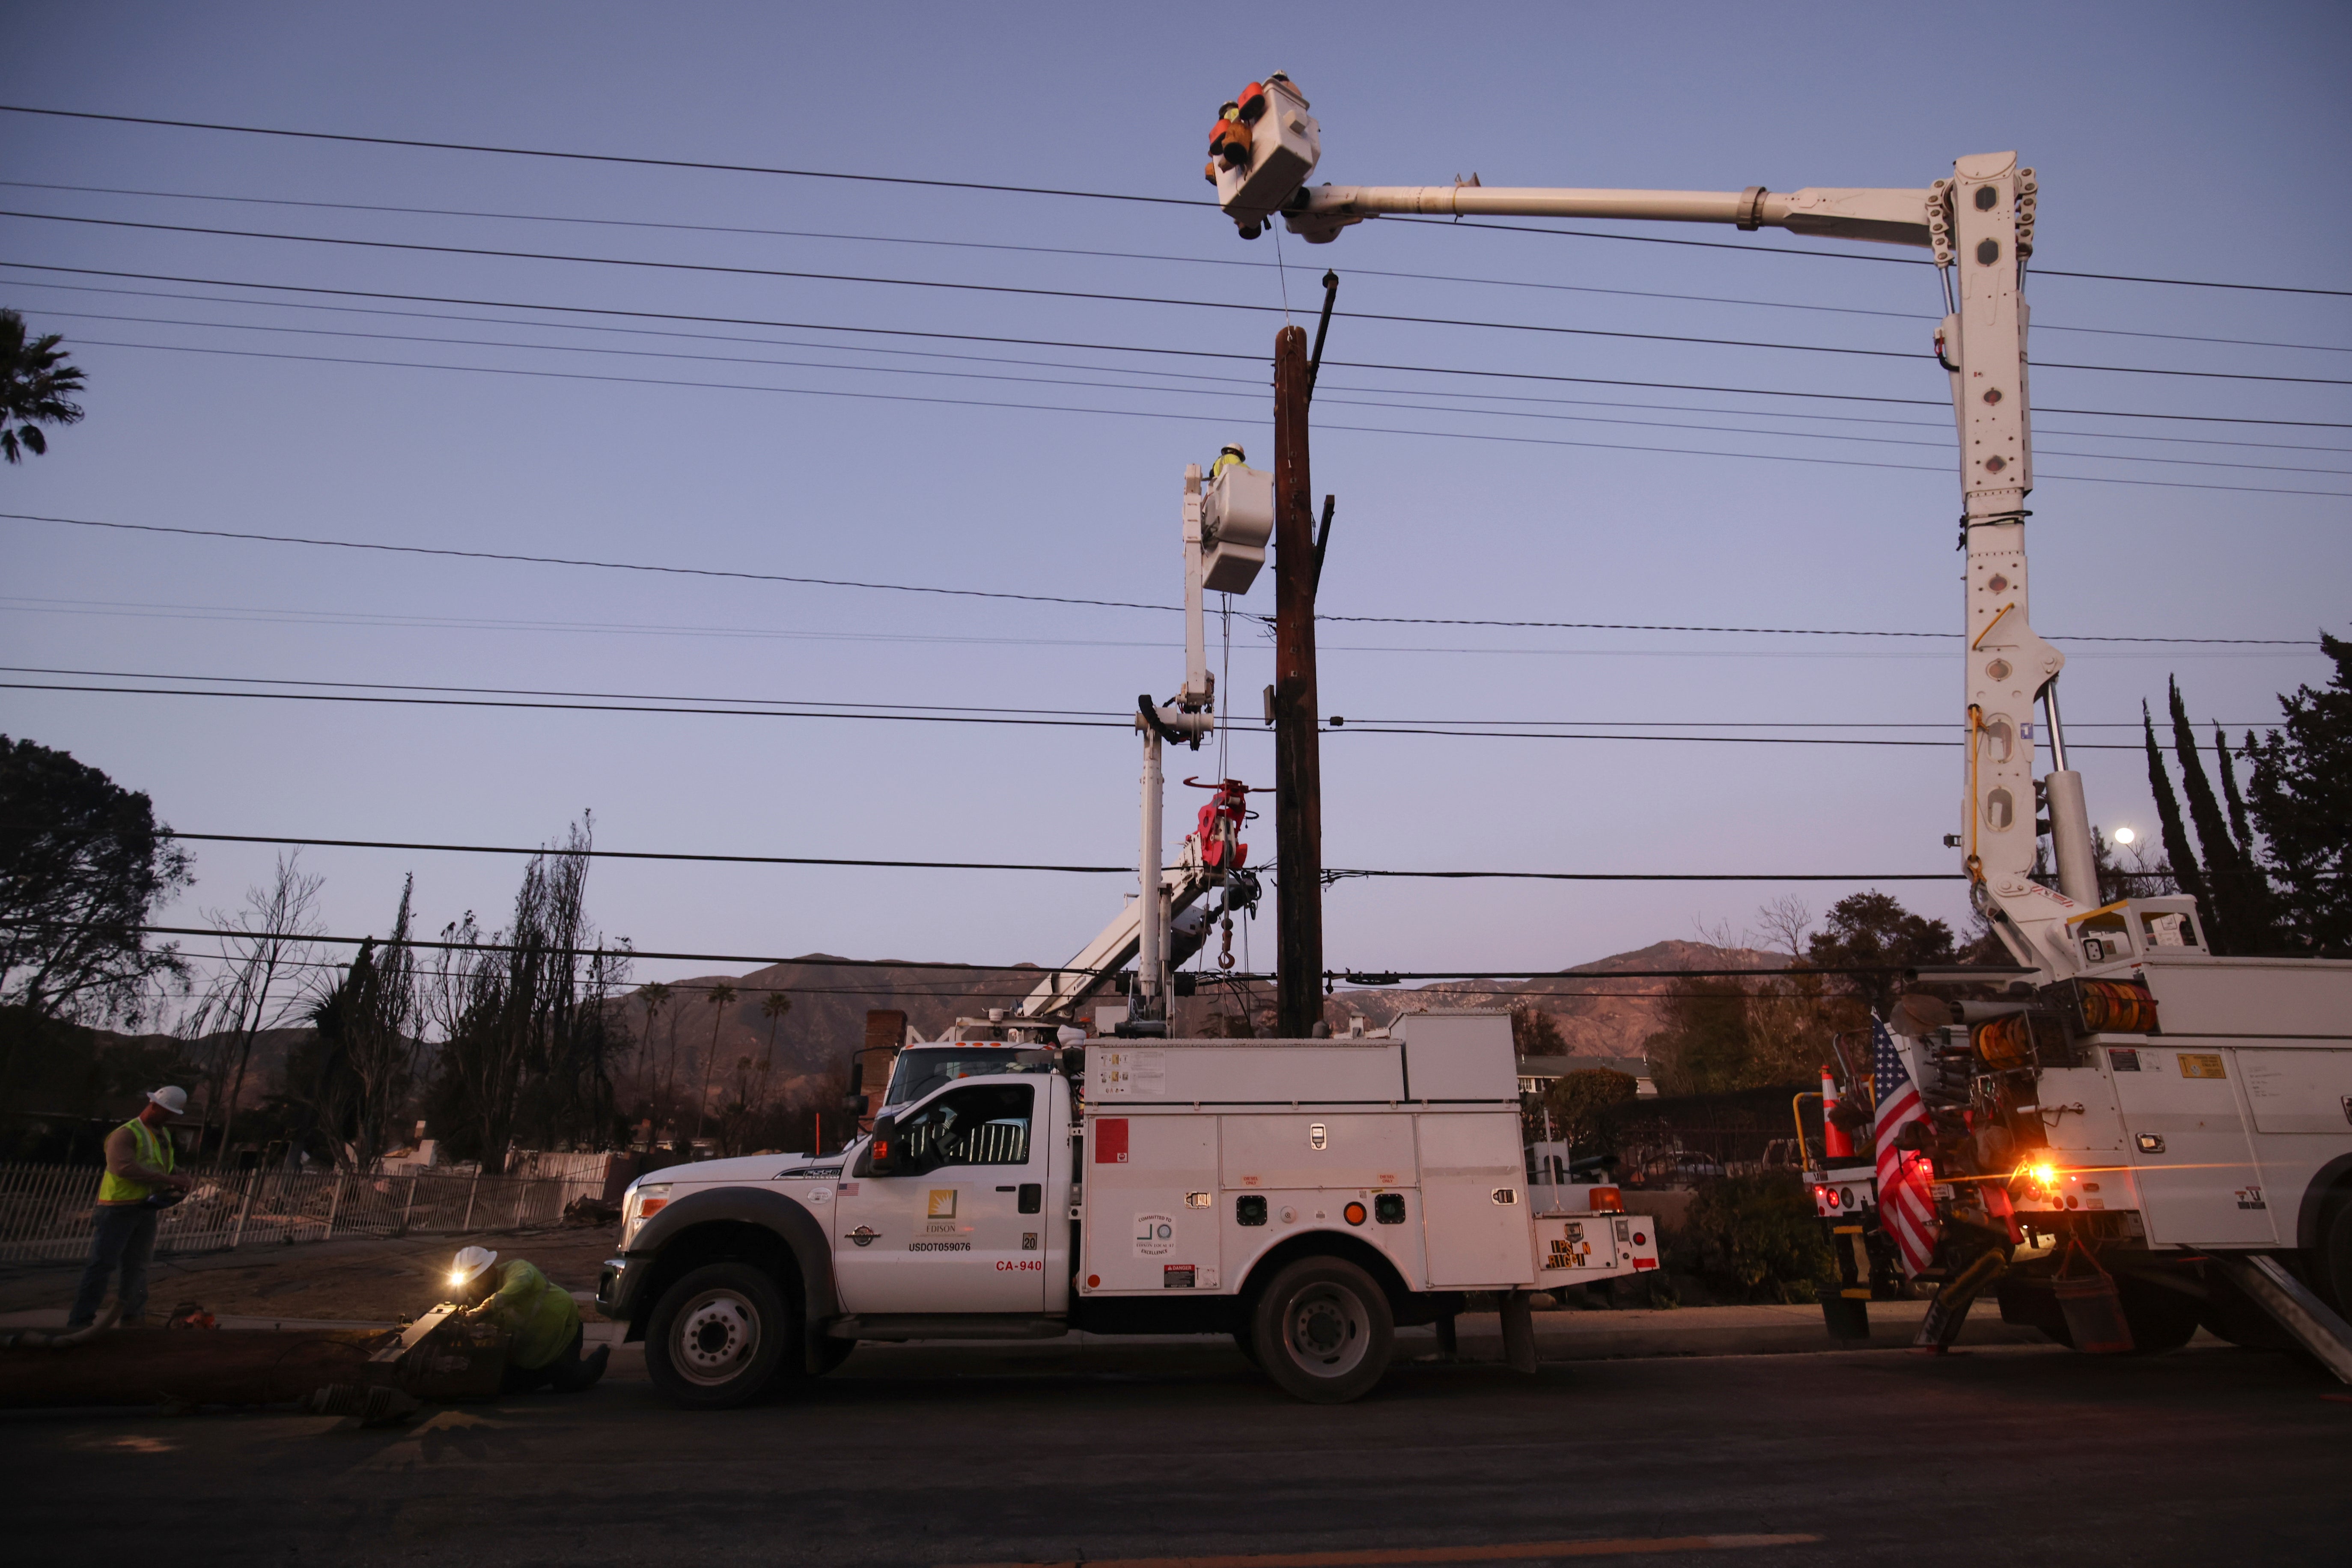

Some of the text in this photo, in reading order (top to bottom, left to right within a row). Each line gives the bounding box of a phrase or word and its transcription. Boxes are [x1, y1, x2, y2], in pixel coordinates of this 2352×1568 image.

[909, 1243, 971, 1251] USDOT059076
[1024, 1238, 1035, 1248] 20
[996, 1261, 1042, 1270] CA-940
